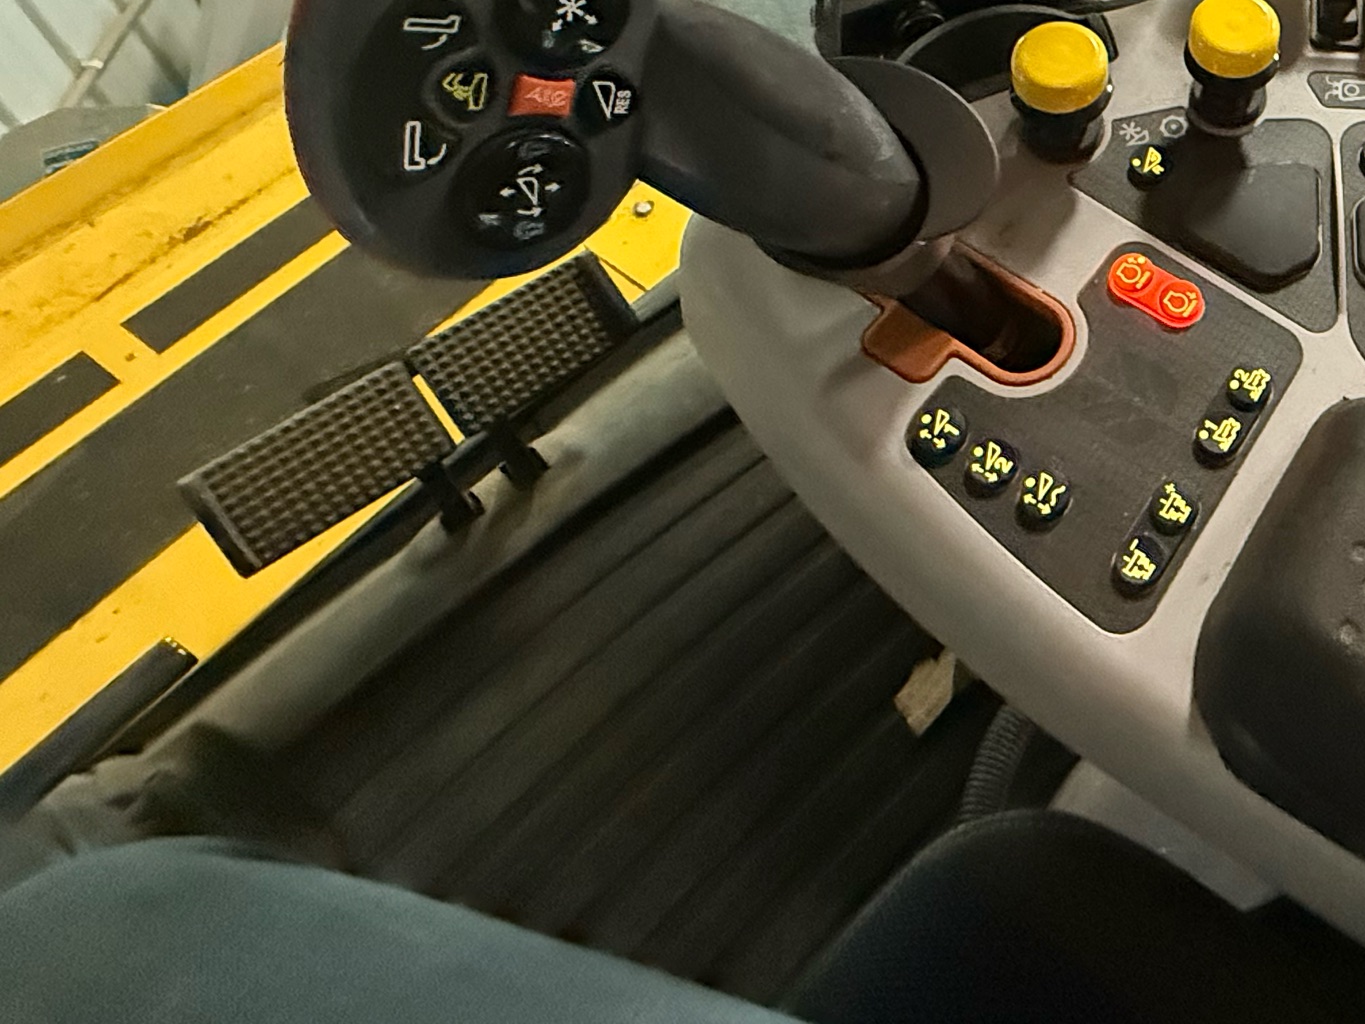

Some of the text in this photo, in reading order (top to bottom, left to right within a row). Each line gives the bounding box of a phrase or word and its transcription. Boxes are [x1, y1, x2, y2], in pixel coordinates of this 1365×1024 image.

[613, 89, 632, 114] RES
[1234, 368, 1249, 382] 2
[994, 456, 1014, 474] 2
